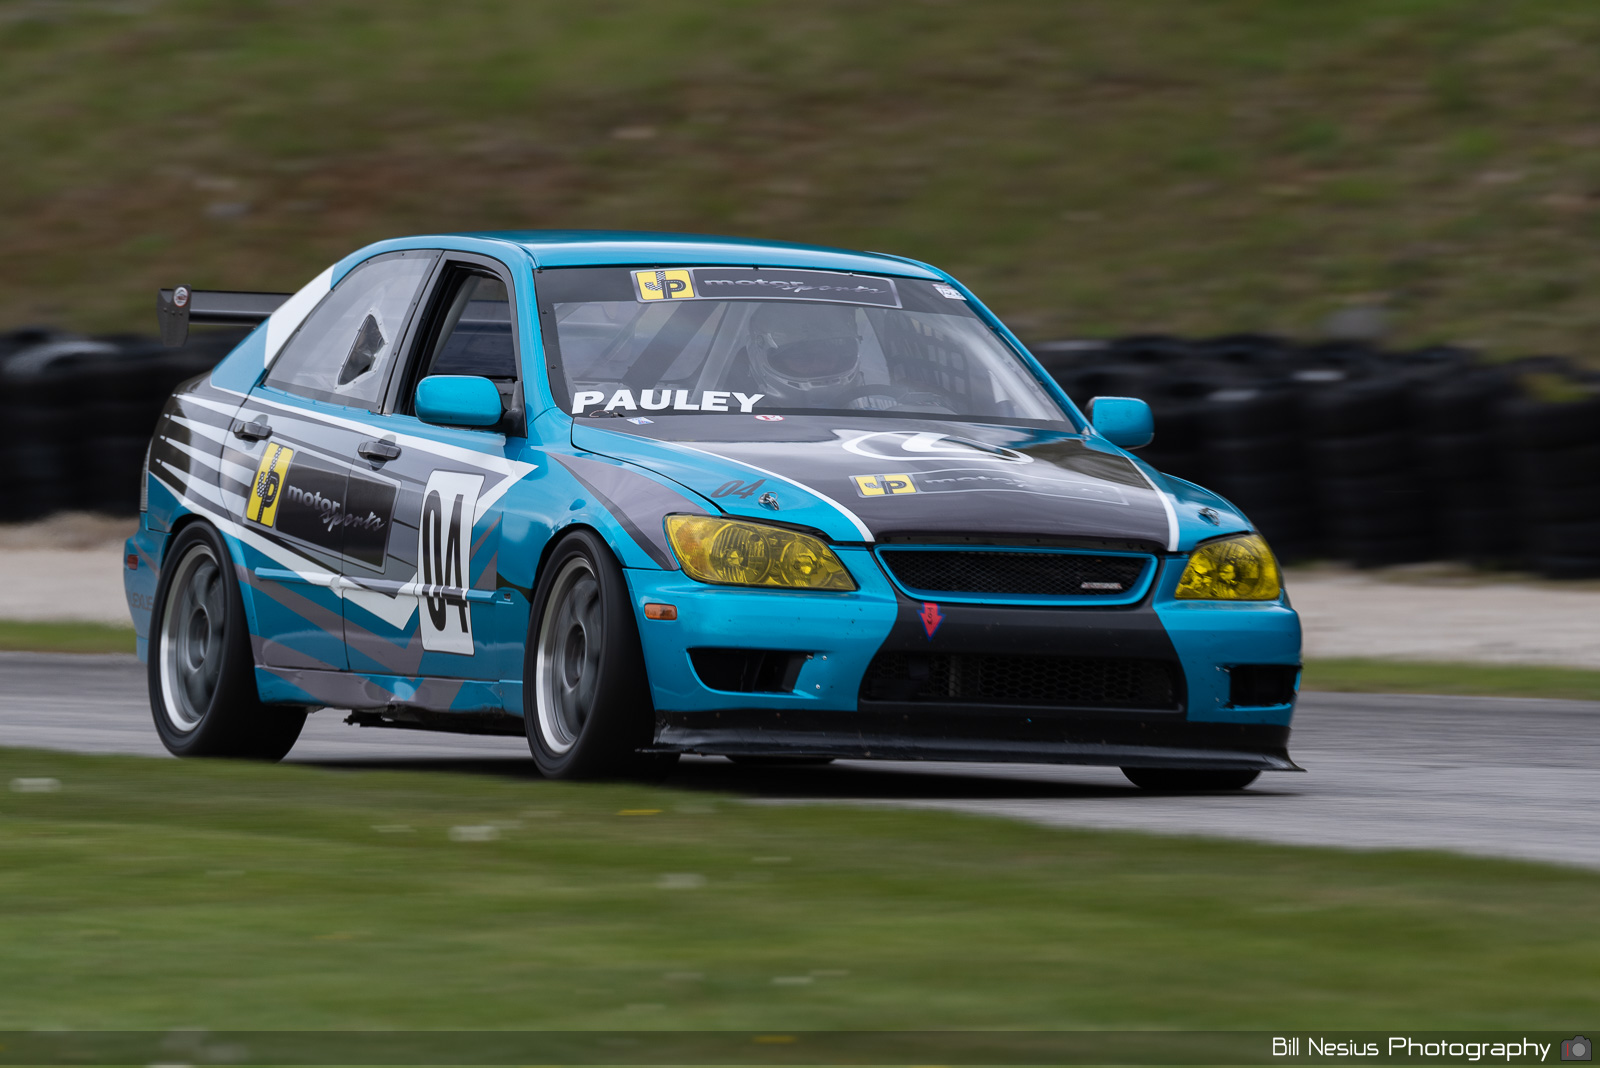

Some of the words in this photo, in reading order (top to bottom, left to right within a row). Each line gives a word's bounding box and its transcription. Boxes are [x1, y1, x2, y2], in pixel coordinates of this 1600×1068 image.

[645, 271, 687, 299] JP
[704, 278, 804, 287] motor
[571, 389, 766, 415] PAULEY
[710, 478, 767, 499] 04
[288, 484, 340, 514] motor
[320, 511, 387, 532] sports
[422, 489, 469, 633] 04
